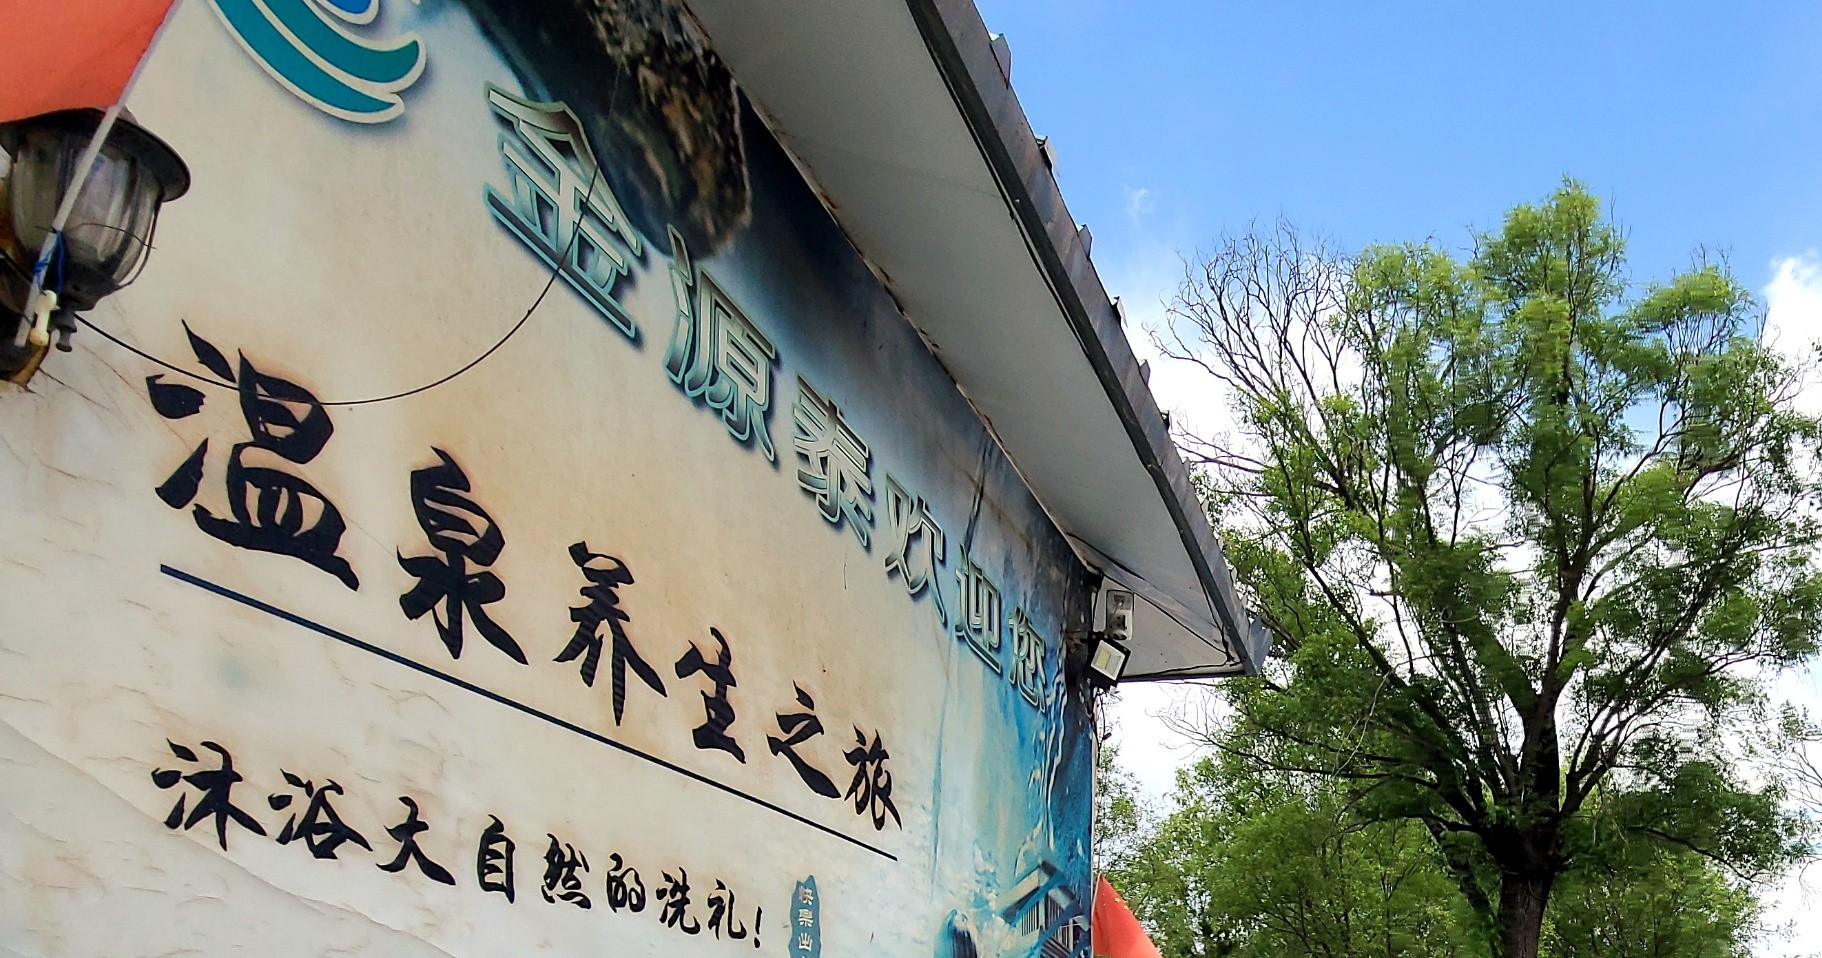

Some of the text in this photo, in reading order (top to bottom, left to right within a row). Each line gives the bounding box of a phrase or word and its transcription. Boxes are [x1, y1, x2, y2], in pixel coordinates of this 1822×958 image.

[146, 319, 902, 830] 温泉养生之旅
[484, 82, 1046, 714] 金源泰欢迎您
